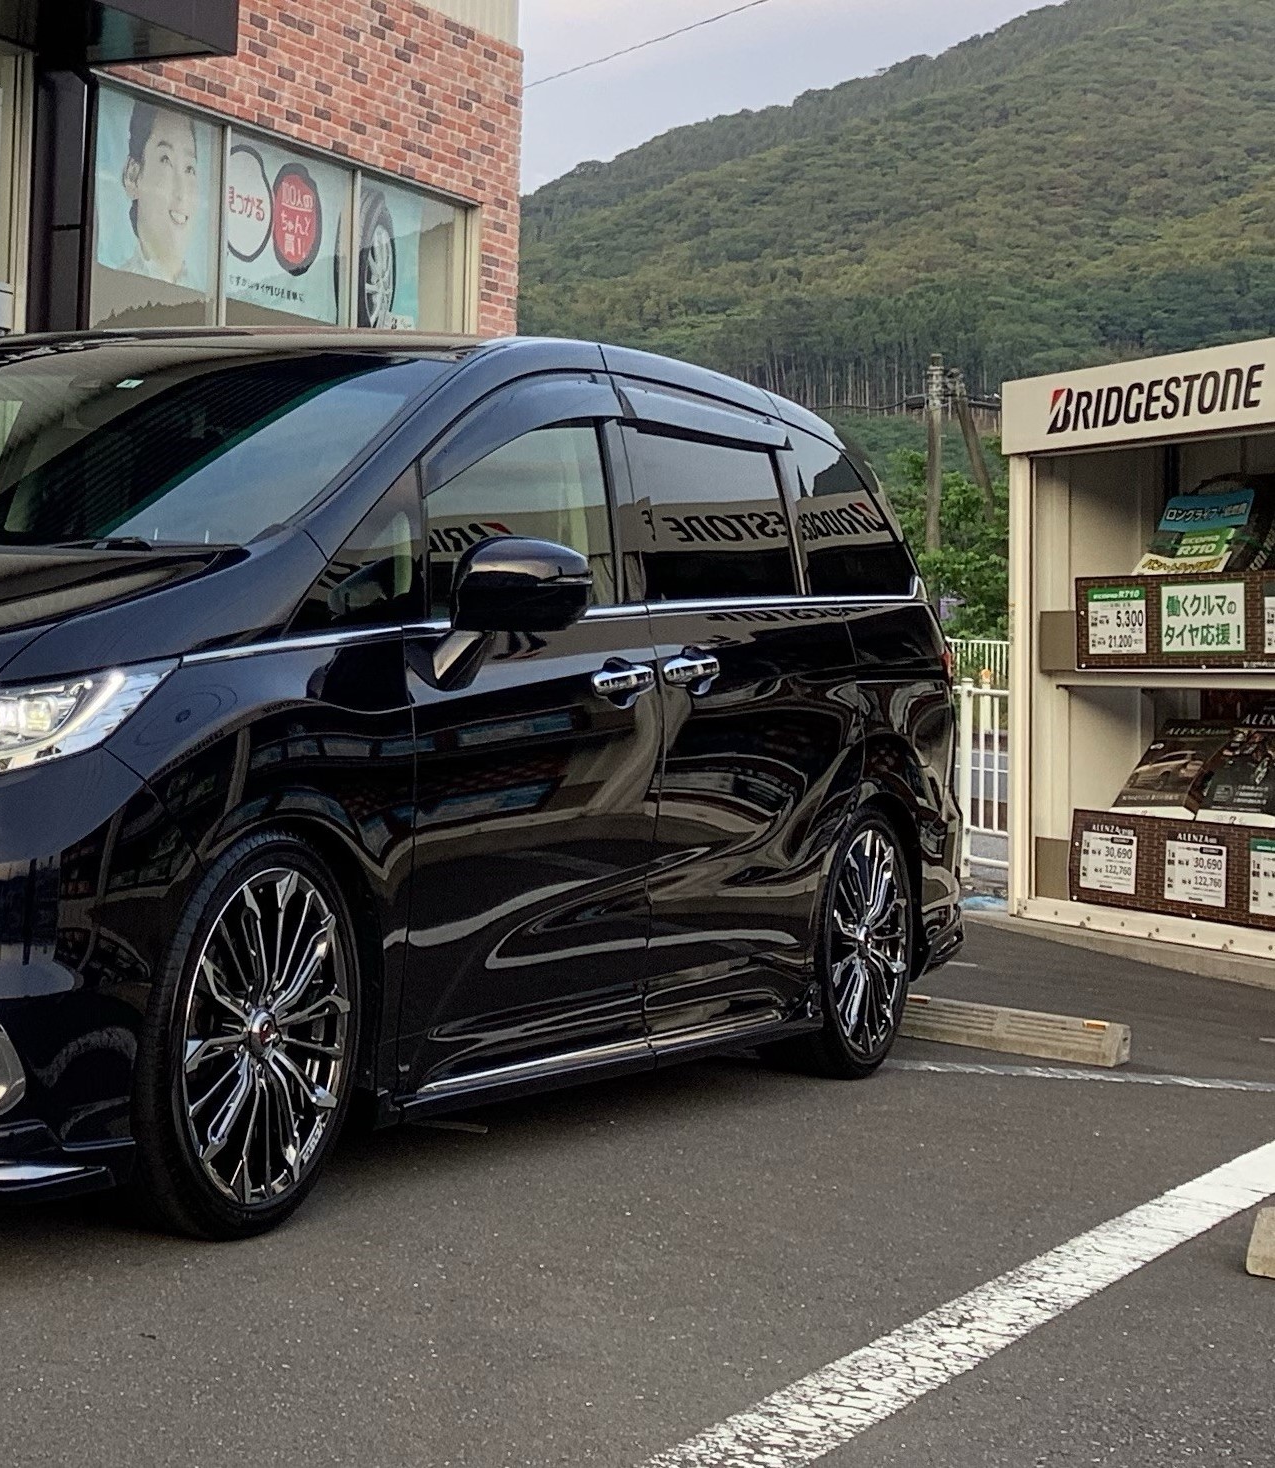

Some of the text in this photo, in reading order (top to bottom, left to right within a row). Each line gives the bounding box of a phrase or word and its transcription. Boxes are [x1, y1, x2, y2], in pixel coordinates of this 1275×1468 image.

[1046, 363, 1266, 435] BRIDGESTONE
[1176, 543, 1217, 556] R710
[1166, 594, 1237, 617] 働くクルマの
[1116, 610, 1143, 628] 5,300
[1177, 832, 1209, 843] ALENZA
[1105, 845, 1133, 860] 30,690
[1193, 856, 1223, 871] 30,690
[1193, 875, 1222, 889] 122,760
